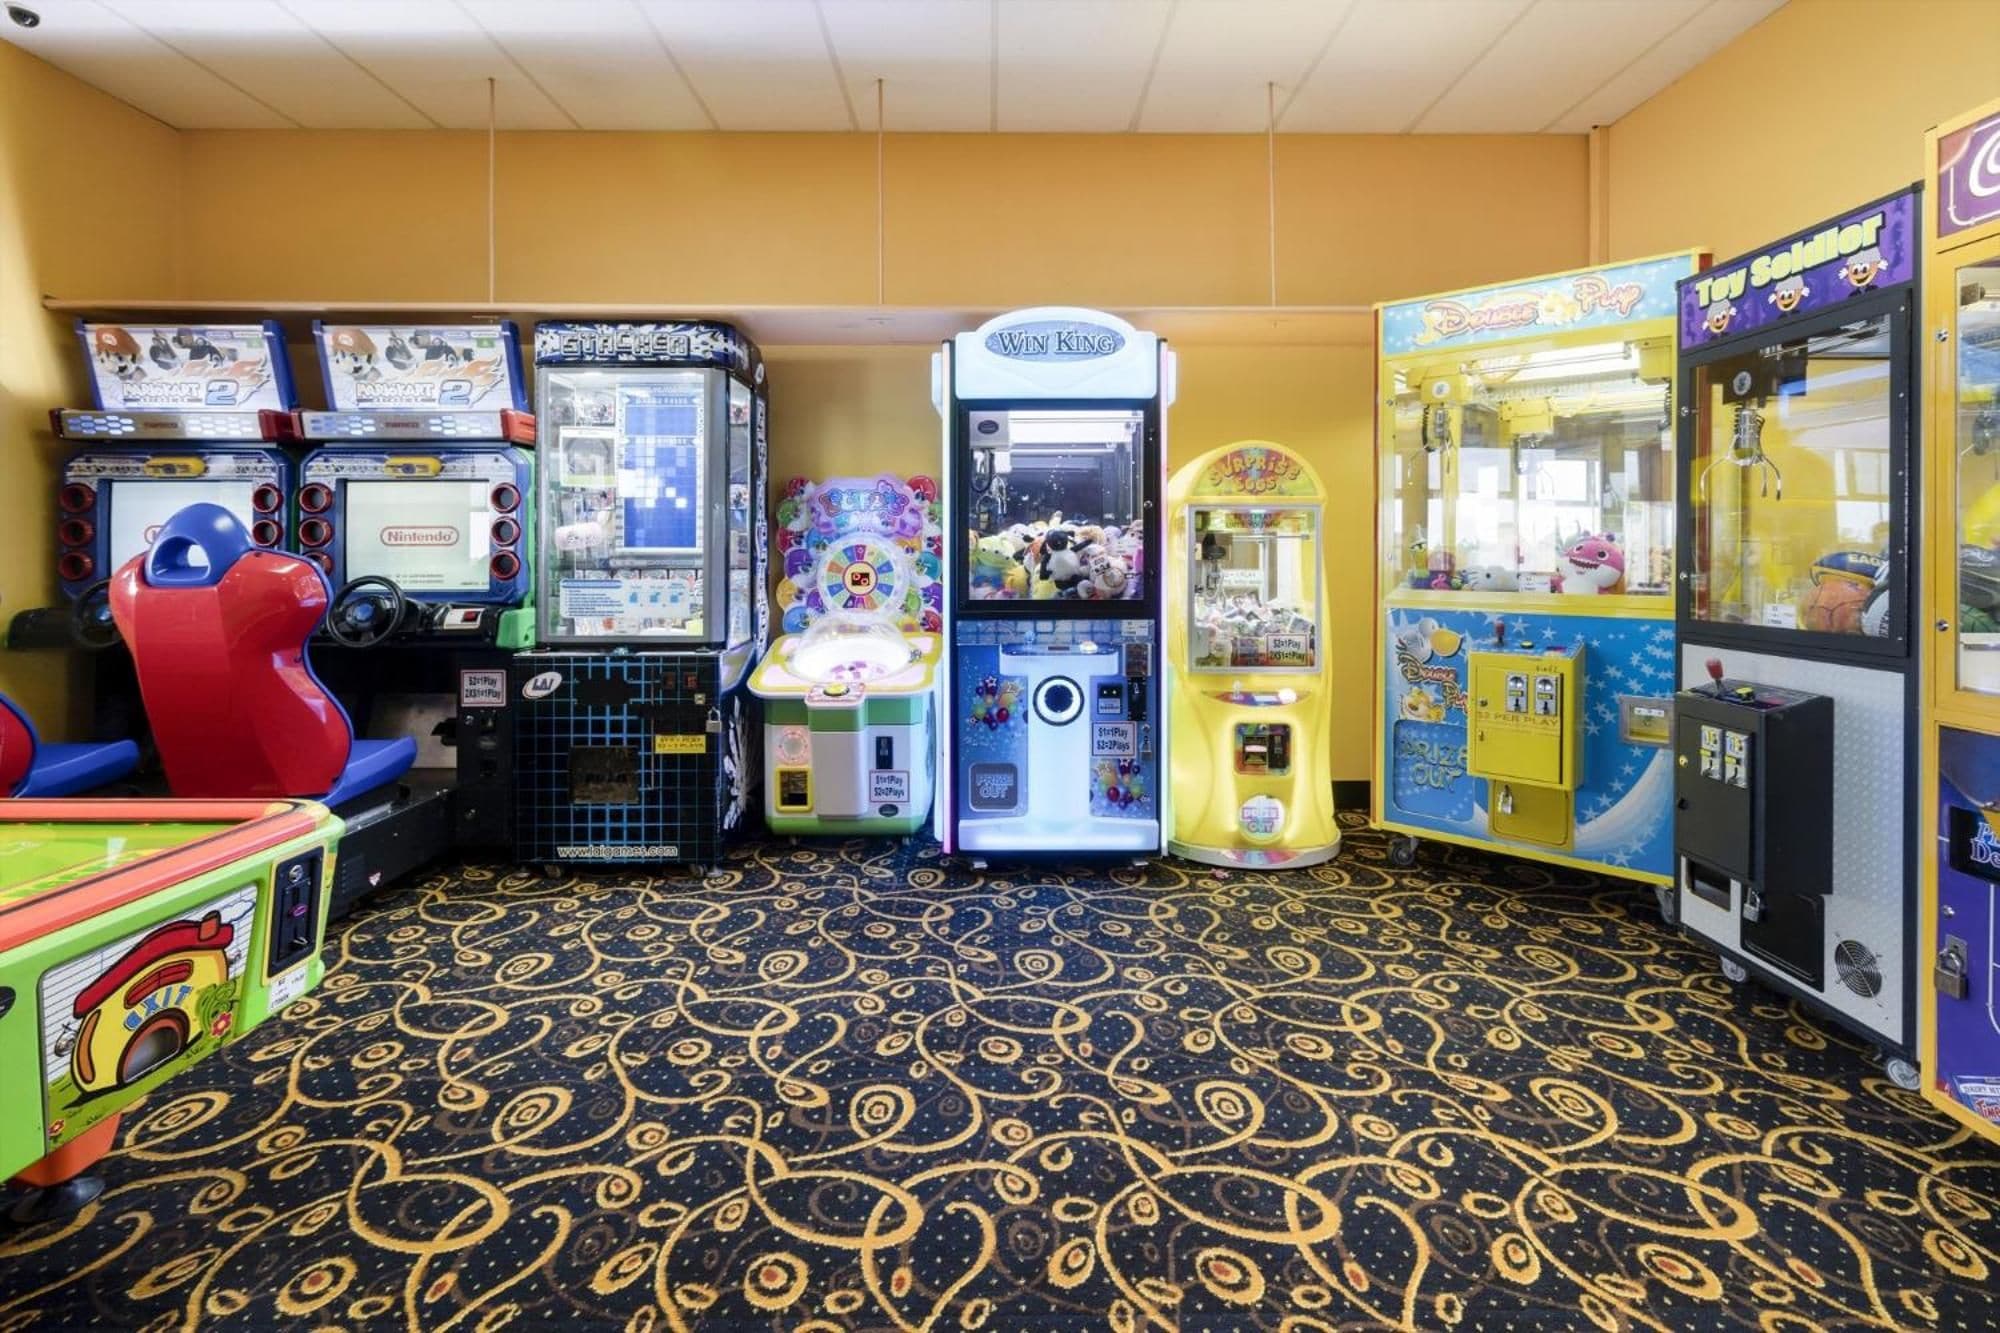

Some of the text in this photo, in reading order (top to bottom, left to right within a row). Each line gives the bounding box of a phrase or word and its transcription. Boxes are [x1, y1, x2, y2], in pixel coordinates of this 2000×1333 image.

[1696, 212, 1885, 307] Toy Soldier
[561, 330, 690, 357] STACKER
[205, 379, 240, 406] 2
[438, 378, 473, 405] 2
[387, 530, 453, 542] Nintendo
[1495, 713, 1520, 722] PER
[1524, 716, 1559, 727] PLAY
[1413, 763, 1462, 789] OUT
[557, 844, 678, 860] www.laigames.com
